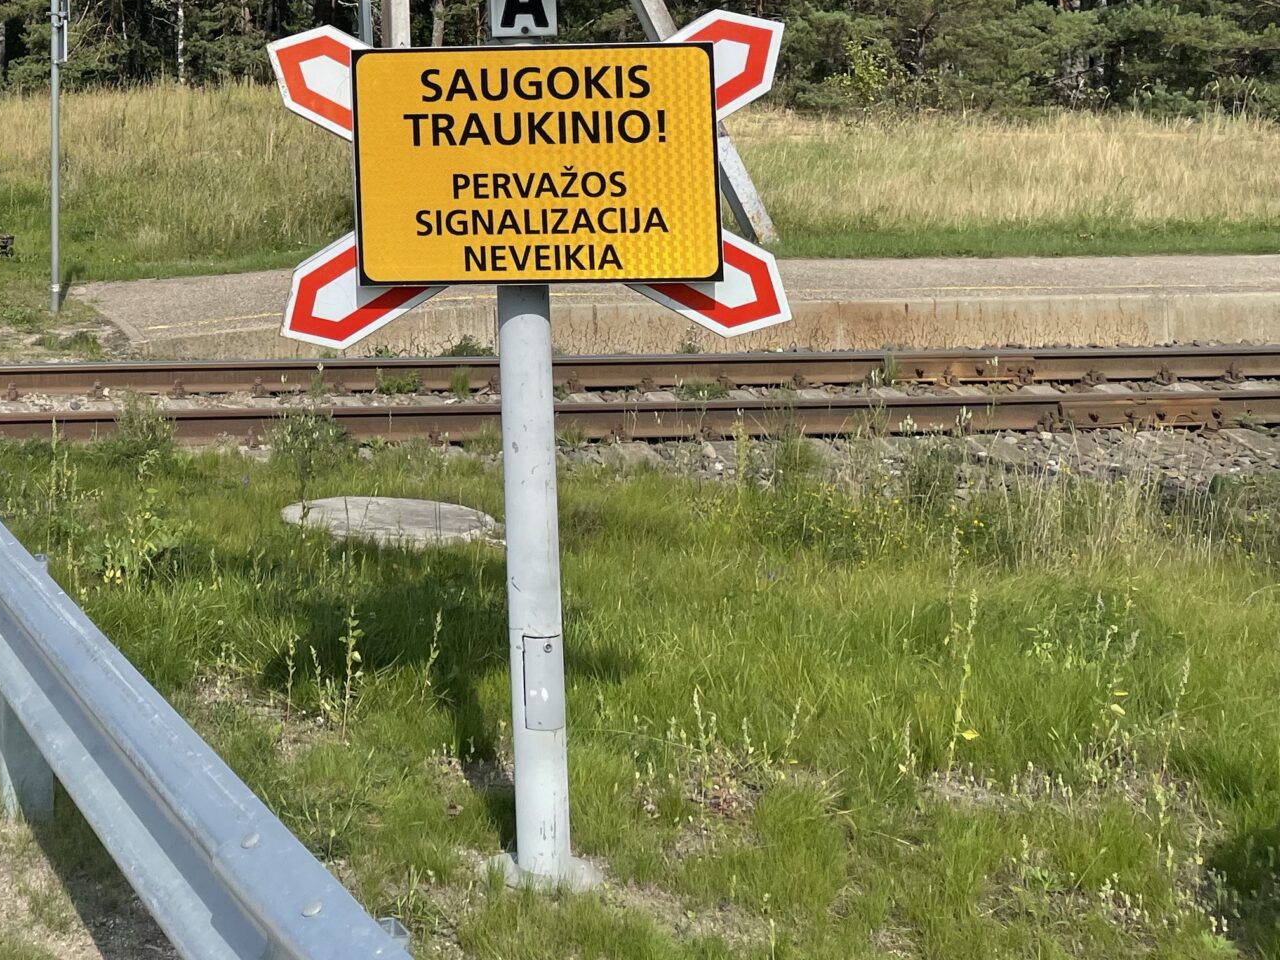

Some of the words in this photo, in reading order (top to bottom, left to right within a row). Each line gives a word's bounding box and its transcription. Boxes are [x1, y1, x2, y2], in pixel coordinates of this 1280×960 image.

[421, 65, 651, 102] SAUGOKIS
[403, 110, 667, 147] TRAUKINIO!
[453, 166, 627, 200] PERVAŽOS
[416, 208, 669, 237] SIGNALIZACIJA
[464, 245, 623, 272] NEVEIKIA
